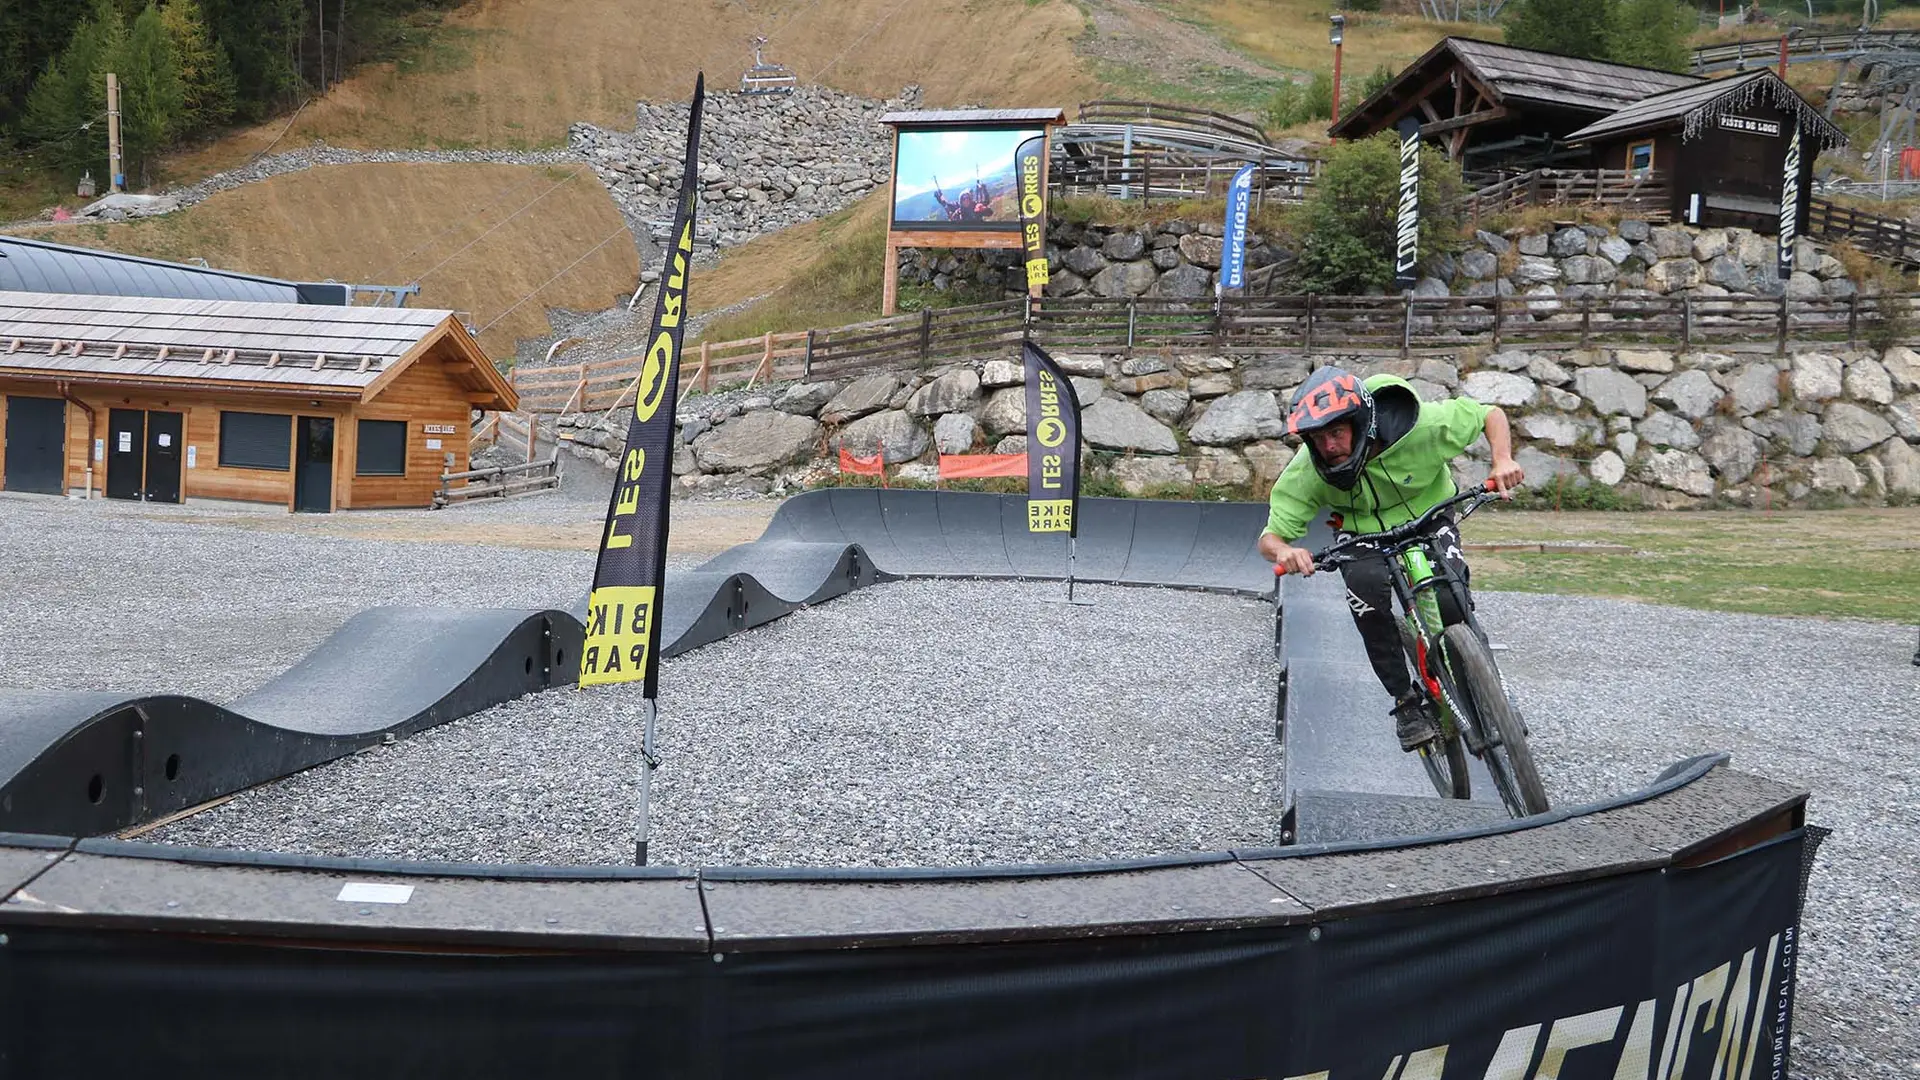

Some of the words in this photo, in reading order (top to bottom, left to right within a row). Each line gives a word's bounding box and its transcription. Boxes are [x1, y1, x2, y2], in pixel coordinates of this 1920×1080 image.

[1721, 117, 1744, 128] PISTE
[1745, 121, 1756, 130] DE
[1022, 155, 1043, 219] ORRES
[1026, 222, 1041, 252] LES
[1287, 374, 1361, 434] FOX
